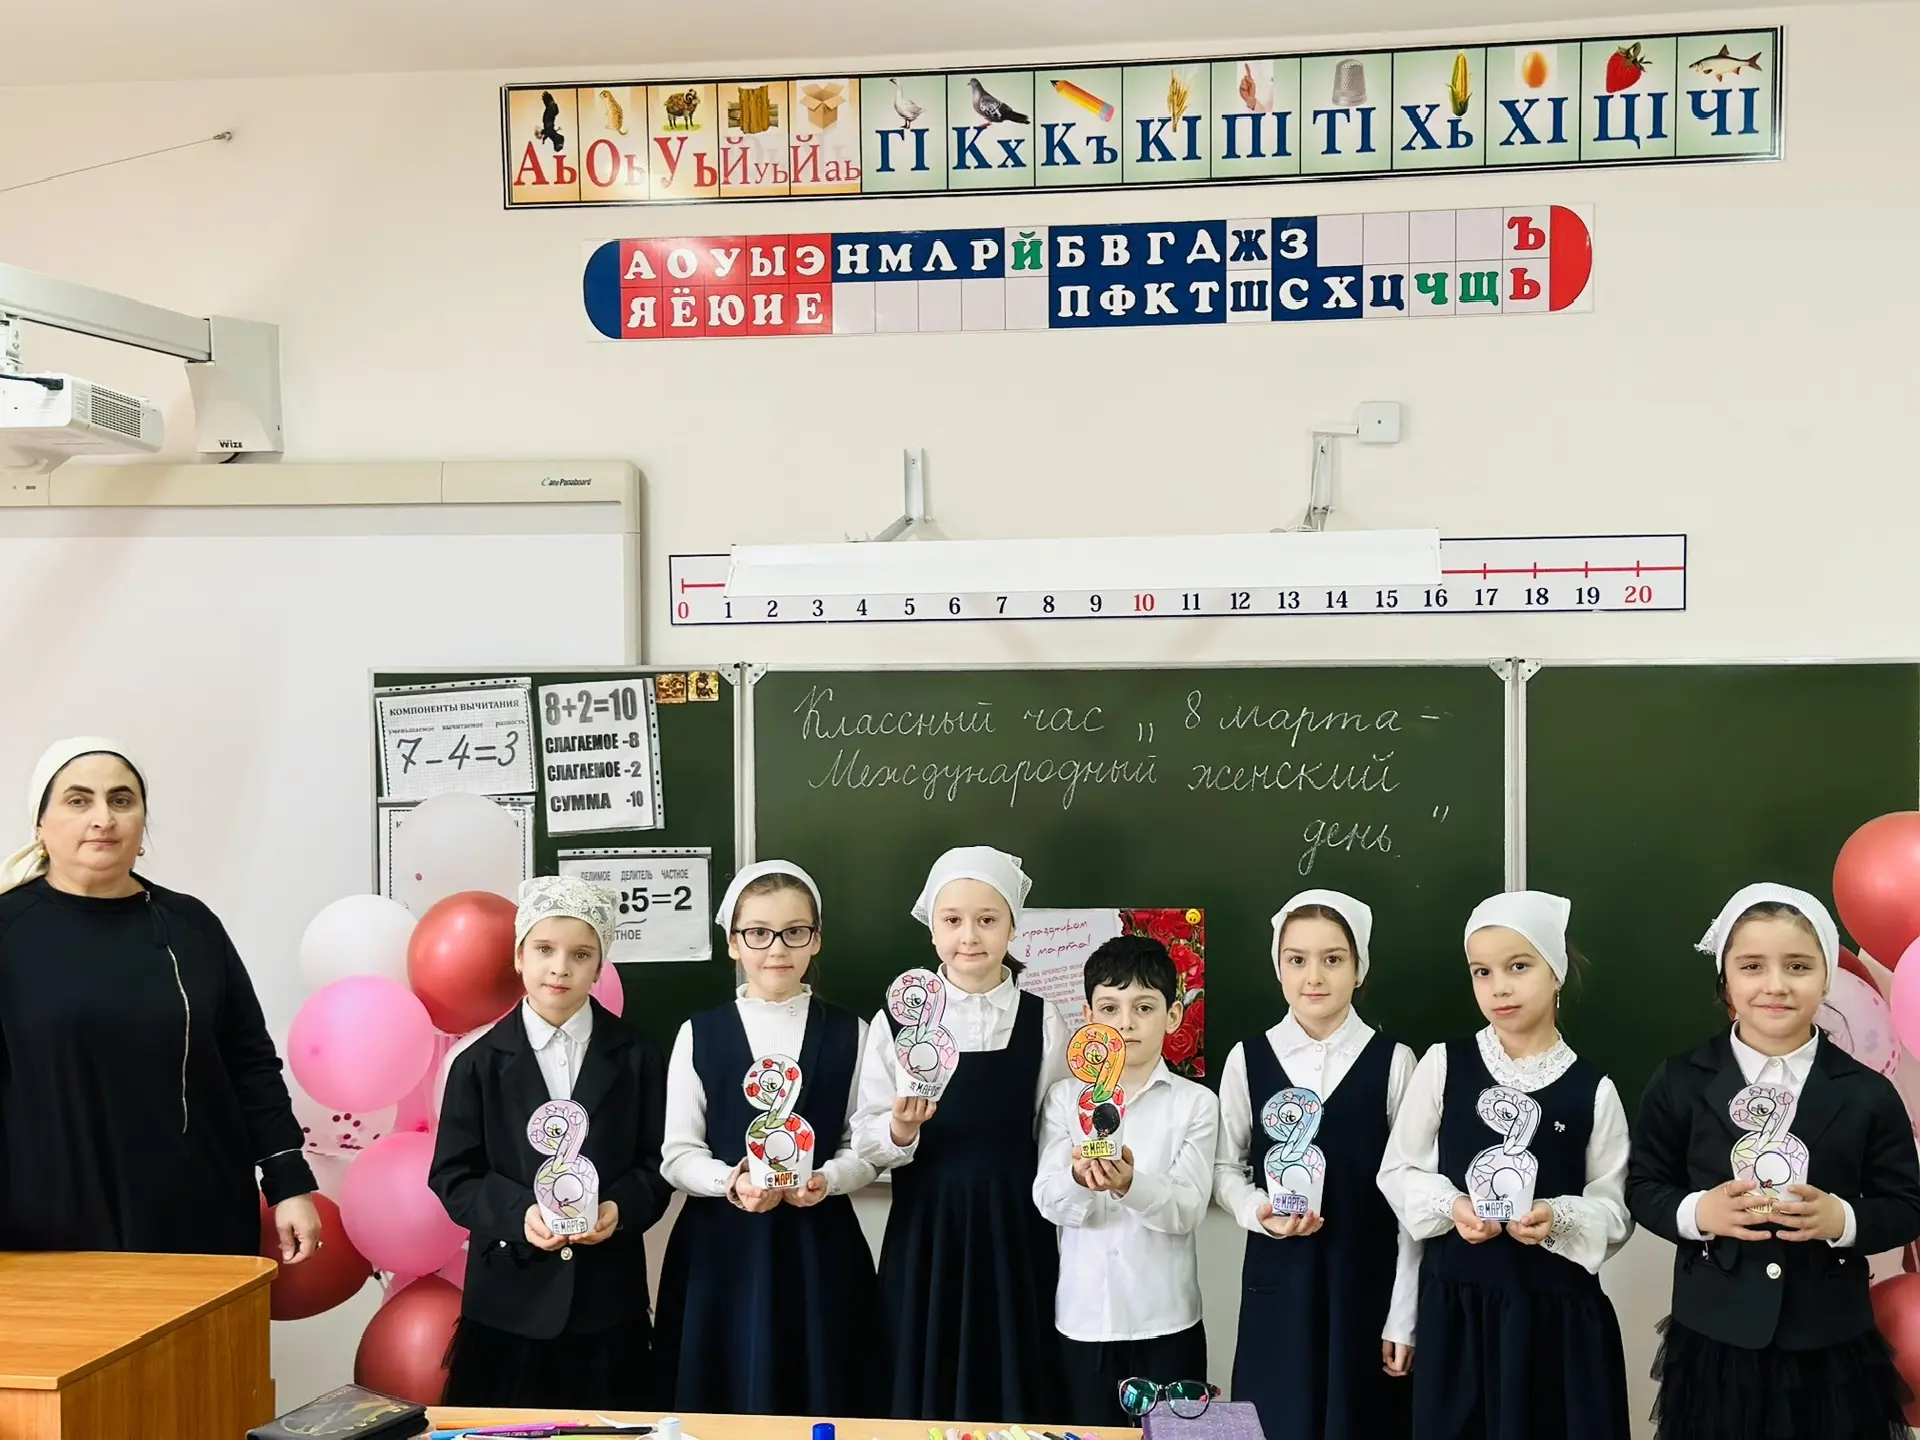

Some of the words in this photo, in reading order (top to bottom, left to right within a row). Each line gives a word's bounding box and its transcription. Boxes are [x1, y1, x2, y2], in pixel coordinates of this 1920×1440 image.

[513, 140, 577, 186] Аь
[586, 138, 647, 187] Оь
[653, 136, 717, 187] Уь
[720, 136, 788, 185] Йуь
[790, 134, 862, 183] Йаь
[953, 126, 1027, 171] Кх
[1041, 123, 1118, 167] Къ
[1401, 105, 1474, 151] Хь
[624, 251, 657, 280] А
[666, 248, 698, 279] О
[711, 248, 748, 278] У
[750, 247, 787, 277] Ы
[796, 246, 827, 276] Э
[836, 244, 870, 275] Н
[879, 244, 913, 273] М
[923, 241, 958, 272] Л
[971, 240, 999, 271] Р
[1012, 231, 1043, 271] Й
[1057, 236, 1085, 267] Б
[1101, 235, 1130, 265] В
[1147, 232, 1175, 264] Г
[1187, 230, 1221, 263] Д
[1230, 229, 1267, 261] Ж
[1281, 229, 1308, 259] З
[1508, 216, 1545, 251] Ъ
[628, 297, 657, 328] Я
[670, 287, 698, 327] Ё
[709, 295, 745, 325] Ю
[753, 294, 784, 324] И
[796, 293, 824, 324] Е
[1058, 286, 1090, 317] П
[1100, 285, 1136, 315] Ф
[1145, 283, 1179, 314] К
[1190, 281, 1220, 312] Т
[1231, 281, 1268, 312] Ш
[1279, 278, 1308, 309] С
[1323, 277, 1358, 308] Х
[1370, 274, 1404, 310] Ц
[1415, 272, 1448, 305] Ч
[1460, 271, 1499, 306] Щ
[1511, 268, 1541, 300] Ь
[678, 602, 689, 619] 0
[724, 602, 732, 618] 1
[767, 600, 778, 617] 2
[813, 599, 824, 616] 3
[856, 599, 868, 616] 4
[904, 598, 916, 615] 5
[948, 597, 961, 614] 6
[996, 597, 1008, 613] 7
[1043, 596, 1055, 613] 8
[1090, 595, 1103, 612] 9
[1134, 594, 1155, 611] 10
[1182, 593, 1201, 610] 11
[1230, 592, 1251, 610] 12
[1278, 591, 1300, 609] 13
[1326, 591, 1348, 608] 14
[1375, 590, 1399, 608] 15
[1424, 589, 1448, 607] 16
[1475, 589, 1499, 606] 17
[1525, 588, 1550, 605] 18
[1575, 587, 1600, 605] 19
[1625, 585, 1653, 604] 20
[389, 704, 458, 716] КОМПОНЕНТЫ
[460, 699, 519, 711] ВЫЧИТАНИЯ
[545, 686, 638, 726] 8+2=10
[793, 685, 996, 740] Классный
[1023, 706, 1105, 732] час
[1219, 705, 1403, 747] марта
[545, 733, 619, 754] СЛАГАЕМОЕ
[547, 761, 621, 782] СЛАГАЕМОЕ
[808, 748, 1158, 810] Международный
[1187, 750, 1401, 792] женский
[550, 792, 612, 812] СУММА
[621, 869, 653, 882] ДЕЛИТЕЛЬ
[660, 868, 689, 879] ЧАСТНОЕ
